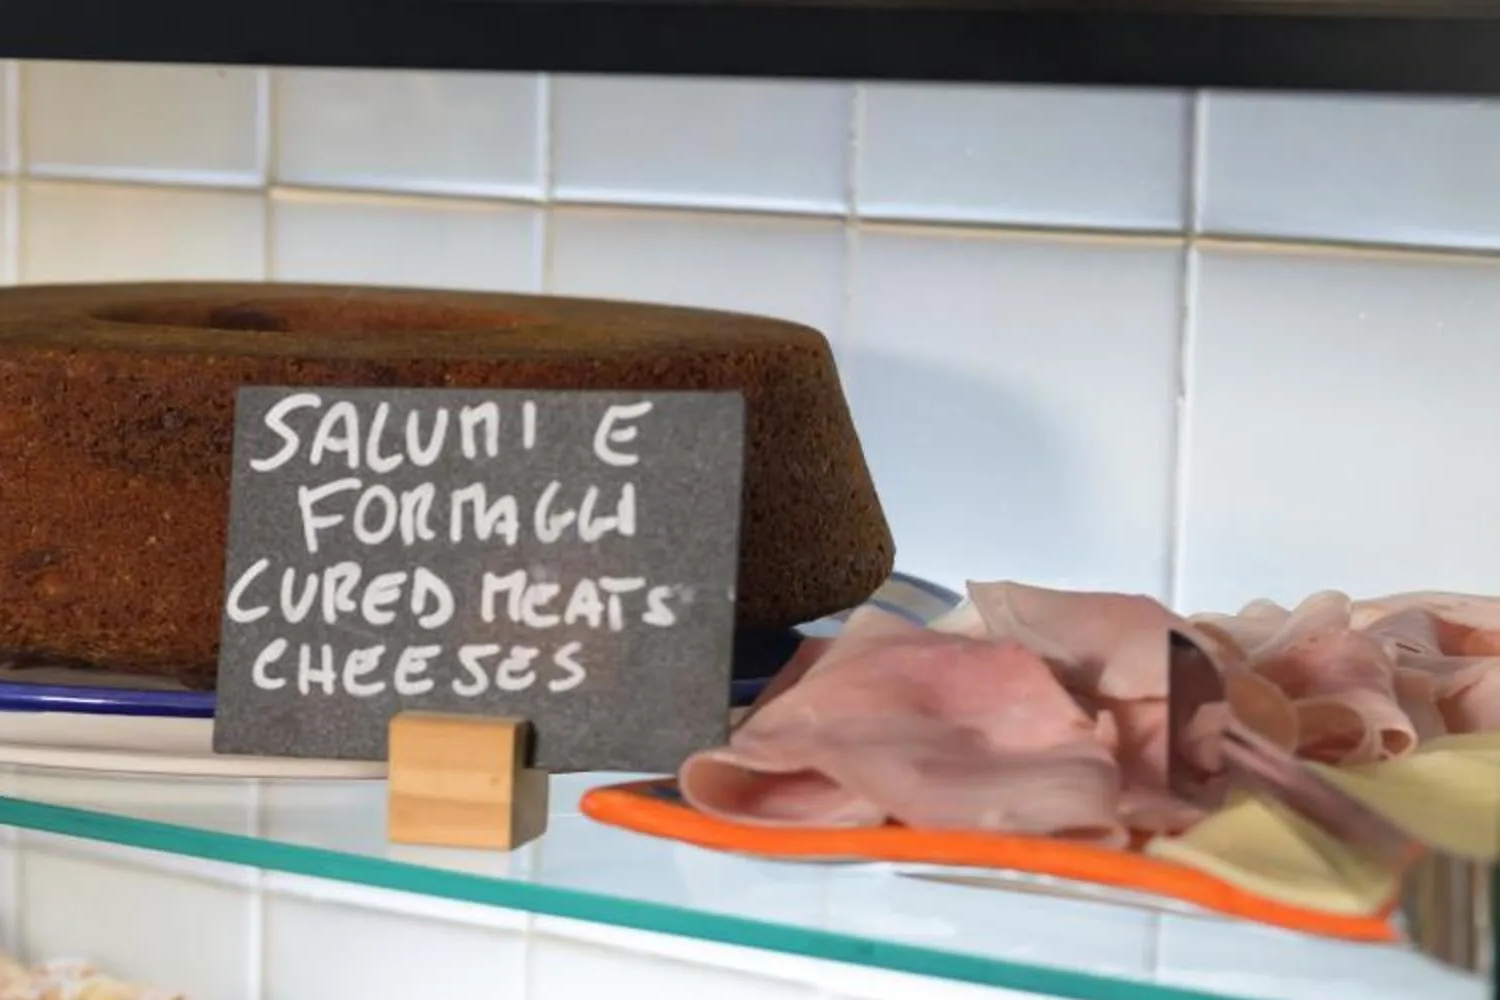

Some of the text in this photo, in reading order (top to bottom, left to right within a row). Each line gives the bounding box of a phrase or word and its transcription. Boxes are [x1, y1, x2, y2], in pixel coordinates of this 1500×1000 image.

[250, 394, 653, 473] SALUMI E
[299, 478, 637, 553] FORMAGGI
[226, 558, 676, 631] CURED MEATS
[252, 638, 586, 696] CHEESES
